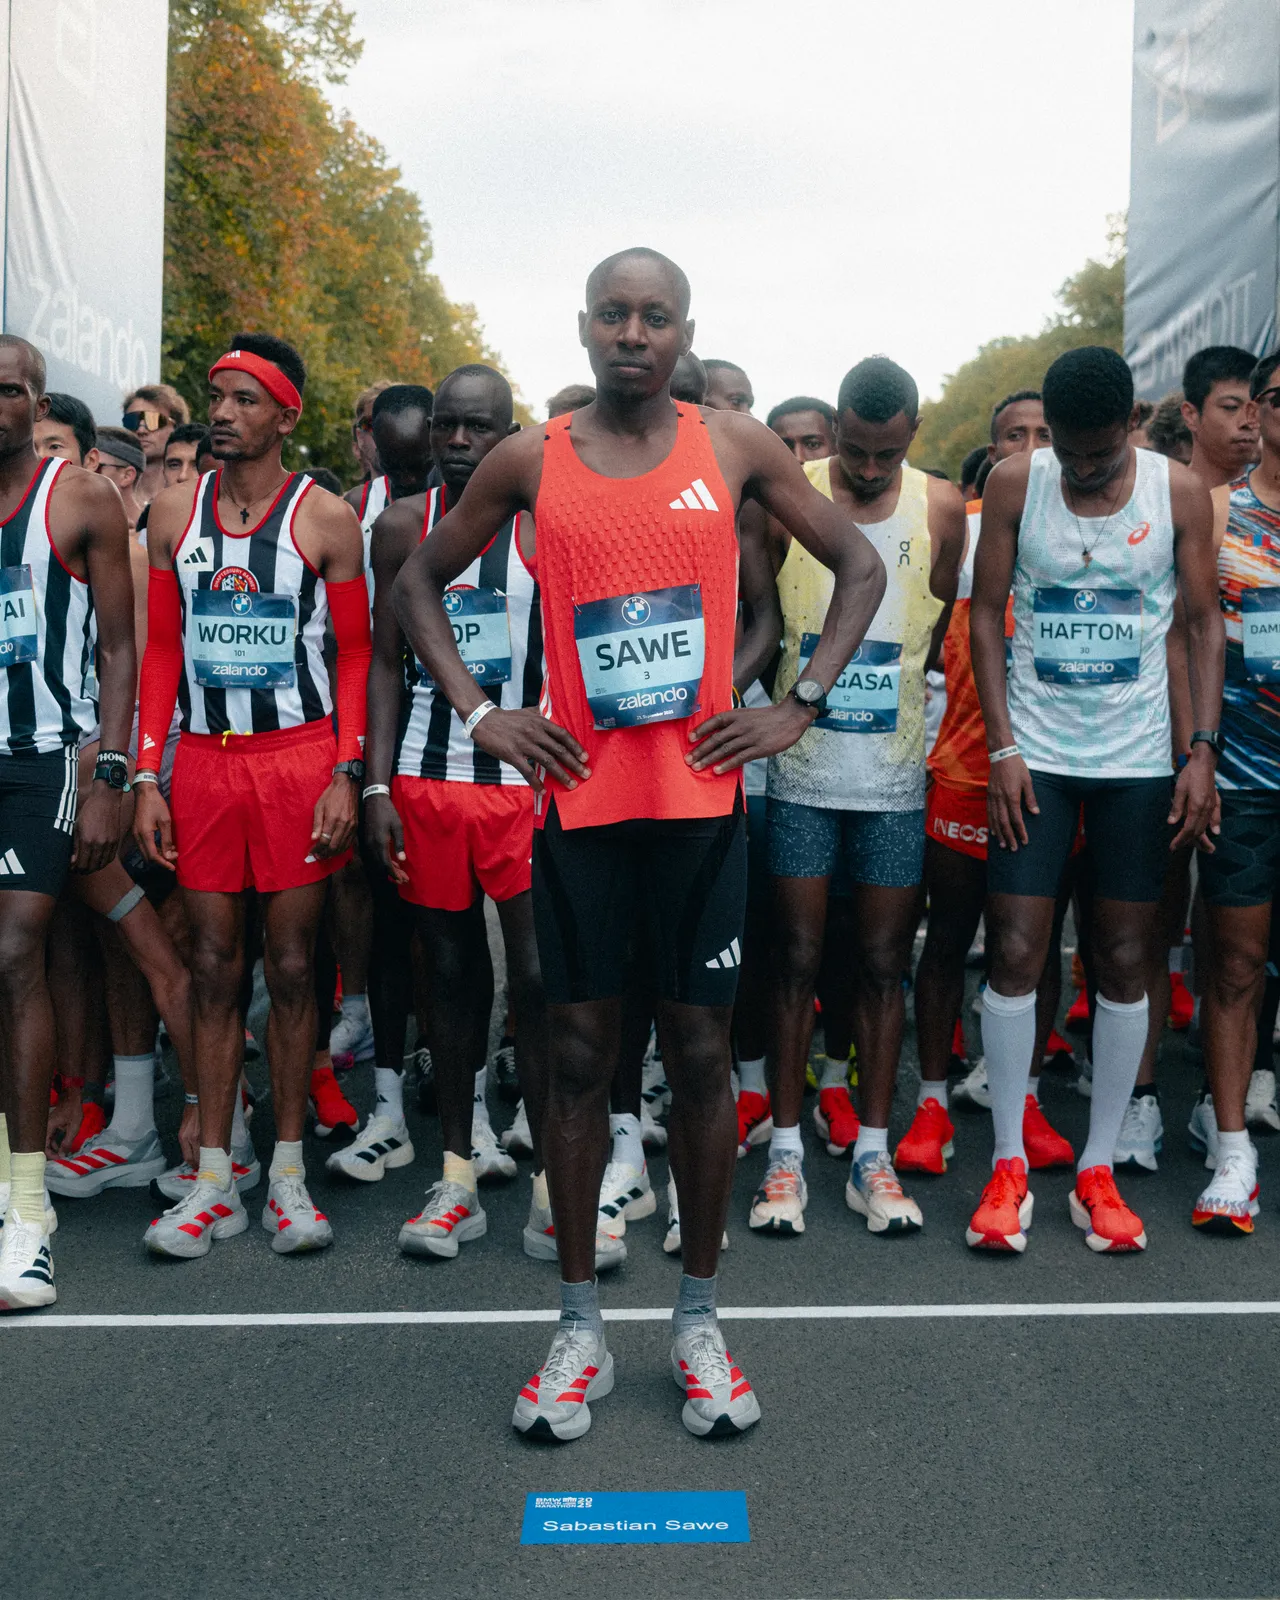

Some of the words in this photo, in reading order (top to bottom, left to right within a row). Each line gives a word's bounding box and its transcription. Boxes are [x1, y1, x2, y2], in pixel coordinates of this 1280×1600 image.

[28, 276, 148, 395] zalando
[0, 598, 25, 621] AI
[198, 622, 286, 645] WORKU
[452, 623, 480, 644] OP
[1040, 622, 1133, 640] HAFTOM
[1250, 624, 1280, 635] DAM
[595, 630, 691, 671] SAWE
[212, 664, 267, 676] zalando
[643, 671, 650, 679] 3
[1058, 661, 1115, 673] zalando
[834, 671, 893, 690] GASA
[617, 687, 687, 711] zalando
[828, 708, 874, 722] alando
[542, 1520, 656, 1531] Sabastian
[665, 1519, 729, 1530] Sawe
